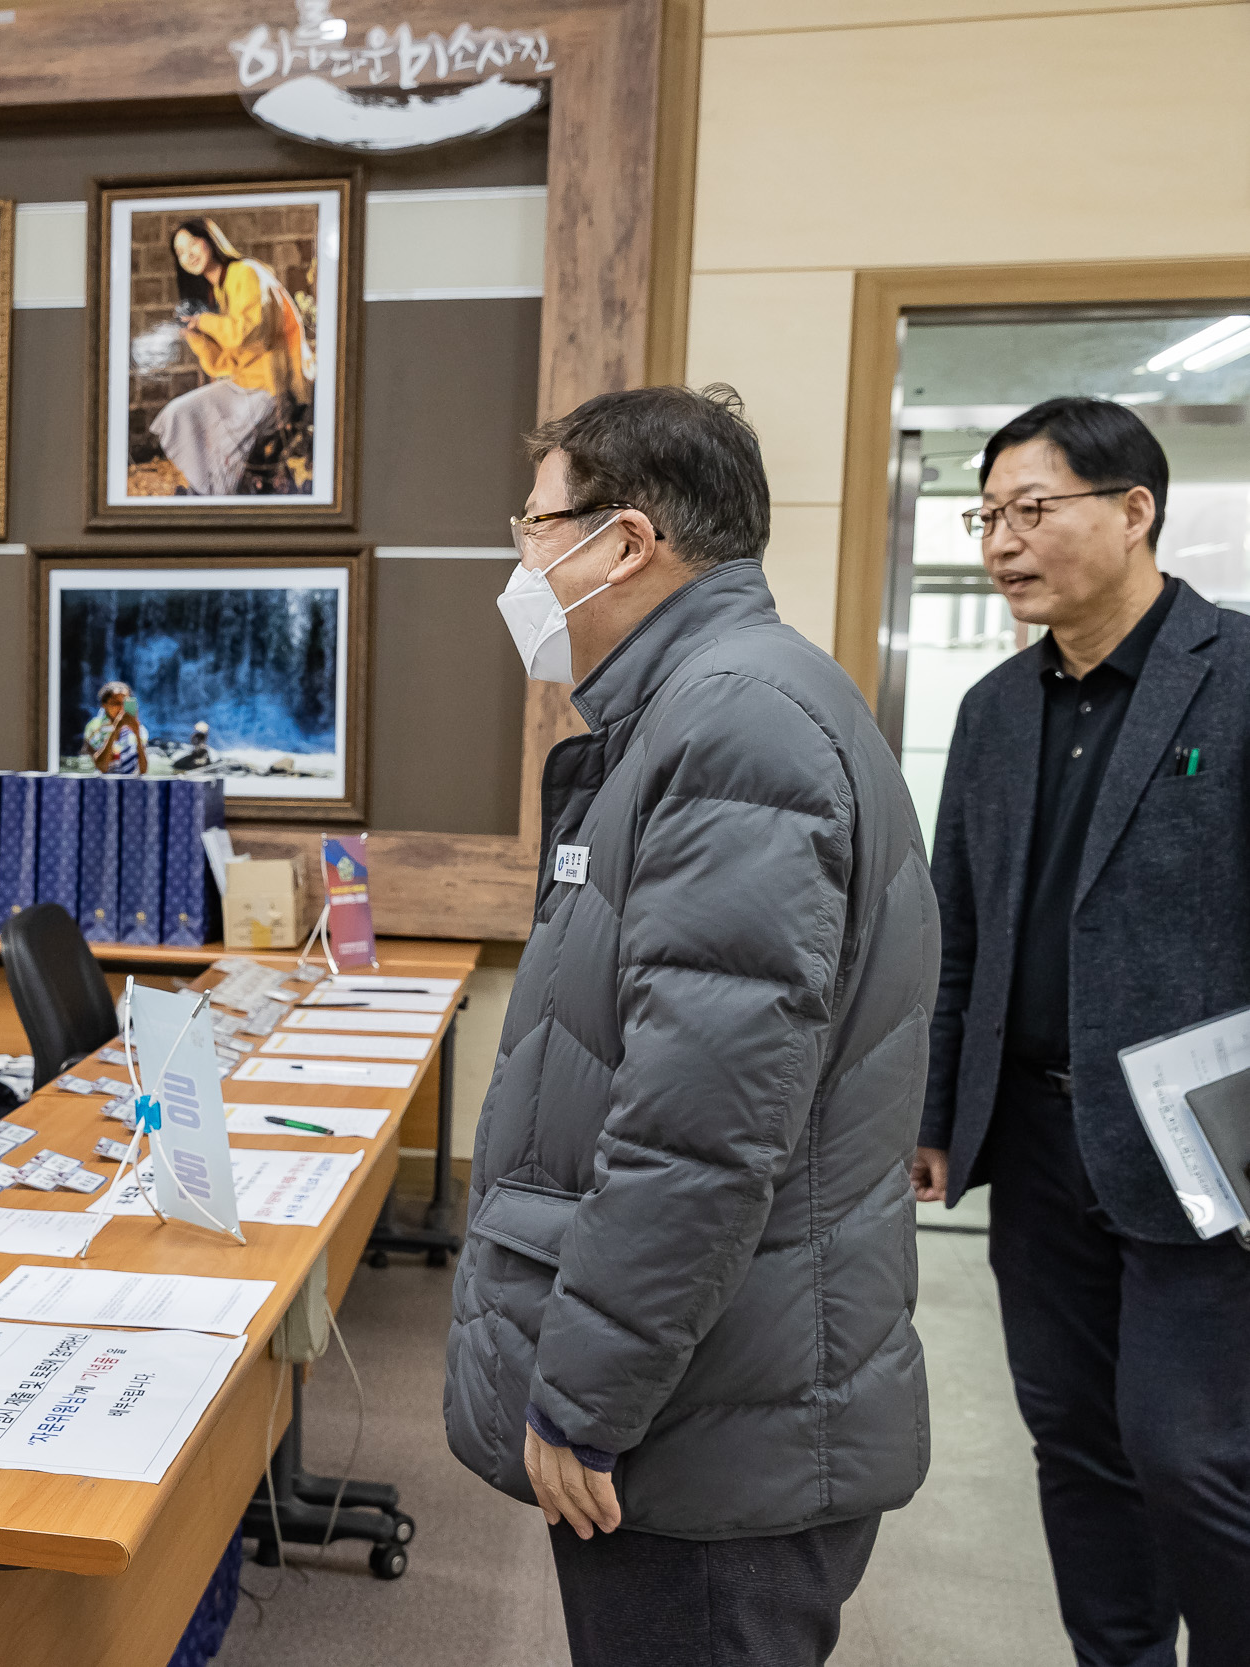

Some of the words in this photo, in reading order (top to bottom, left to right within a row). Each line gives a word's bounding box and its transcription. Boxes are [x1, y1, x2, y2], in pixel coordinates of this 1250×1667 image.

[48, 1333, 89, 1357] 참여하신
[29, 1358, 65, 1379] 토론에
[18, 1380, 46, 1391] 및
[3, 1391, 36, 1407] 제출
